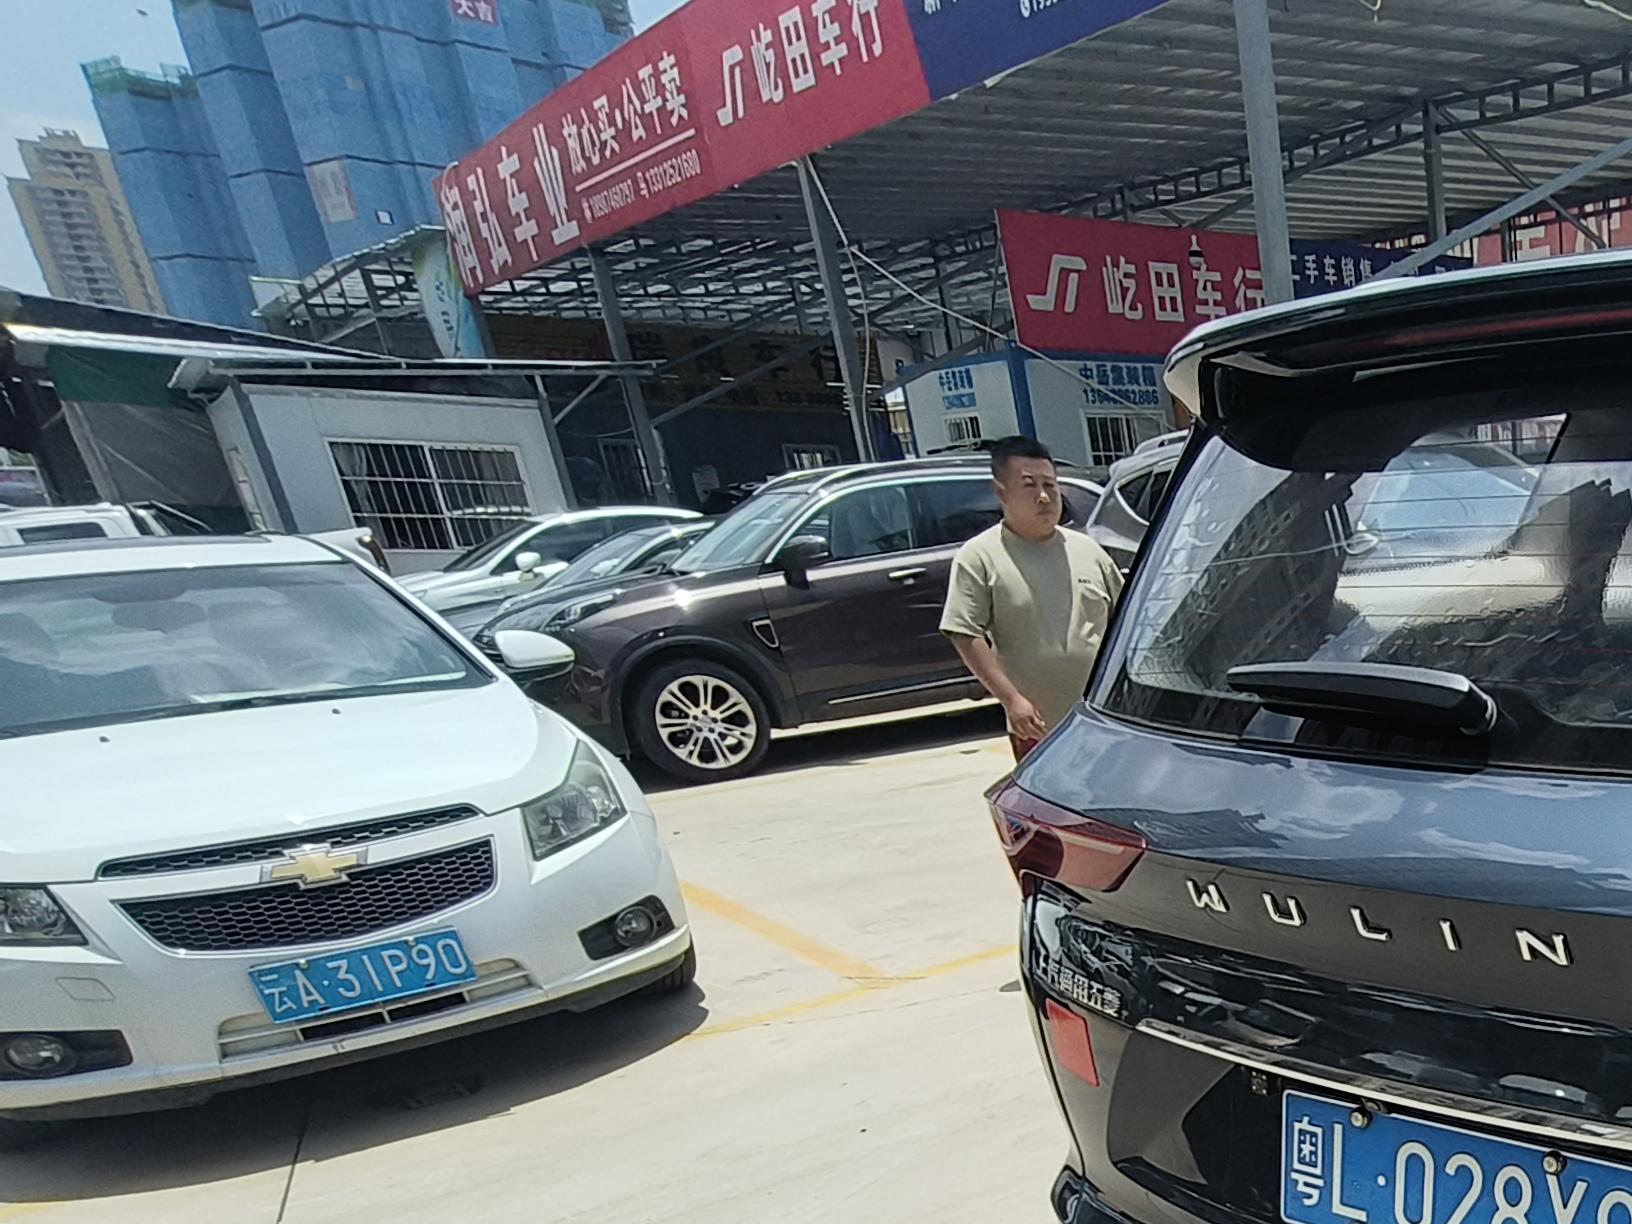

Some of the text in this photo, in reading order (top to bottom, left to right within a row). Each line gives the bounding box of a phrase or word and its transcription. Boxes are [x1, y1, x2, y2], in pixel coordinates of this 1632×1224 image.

[751, 0, 882, 103] 屹田车行
[442, 123, 580, 288] 润弘车业
[1102, 254, 1265, 322] 屹田车行
